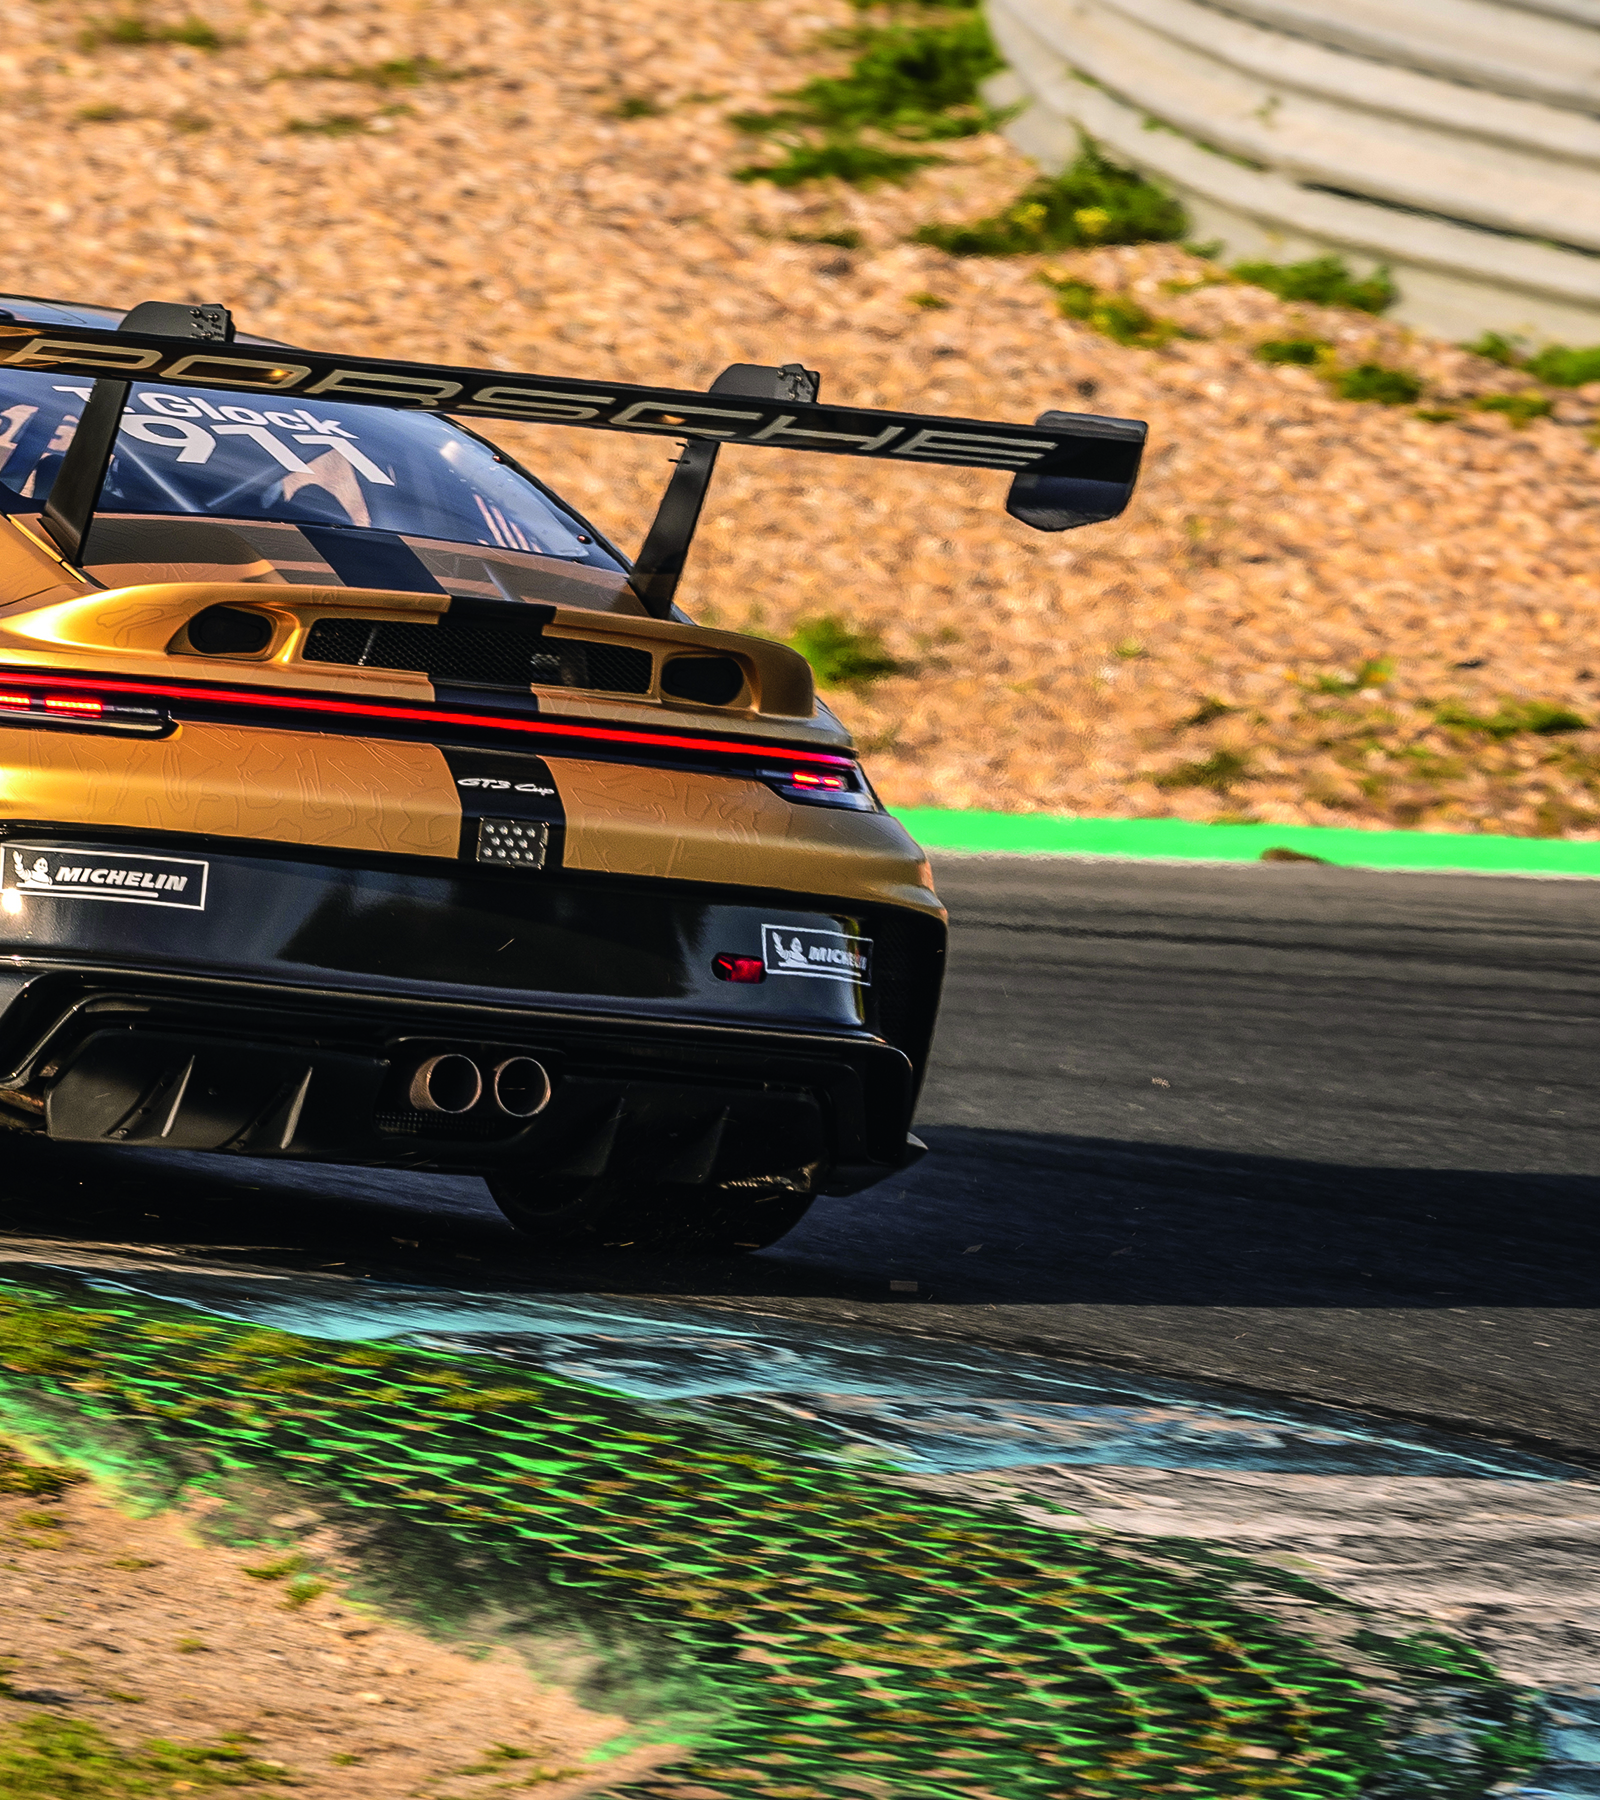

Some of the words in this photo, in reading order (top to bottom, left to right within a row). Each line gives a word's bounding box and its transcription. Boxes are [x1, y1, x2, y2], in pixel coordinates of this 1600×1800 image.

[3, 338, 1058, 468] PORSCHE
[137, 391, 361, 440] Glock
[118, 414, 396, 487] 911
[457, 778, 511, 789] GT3
[514, 783, 555, 796] Cup
[55, 866, 188, 892] MICHELIN
